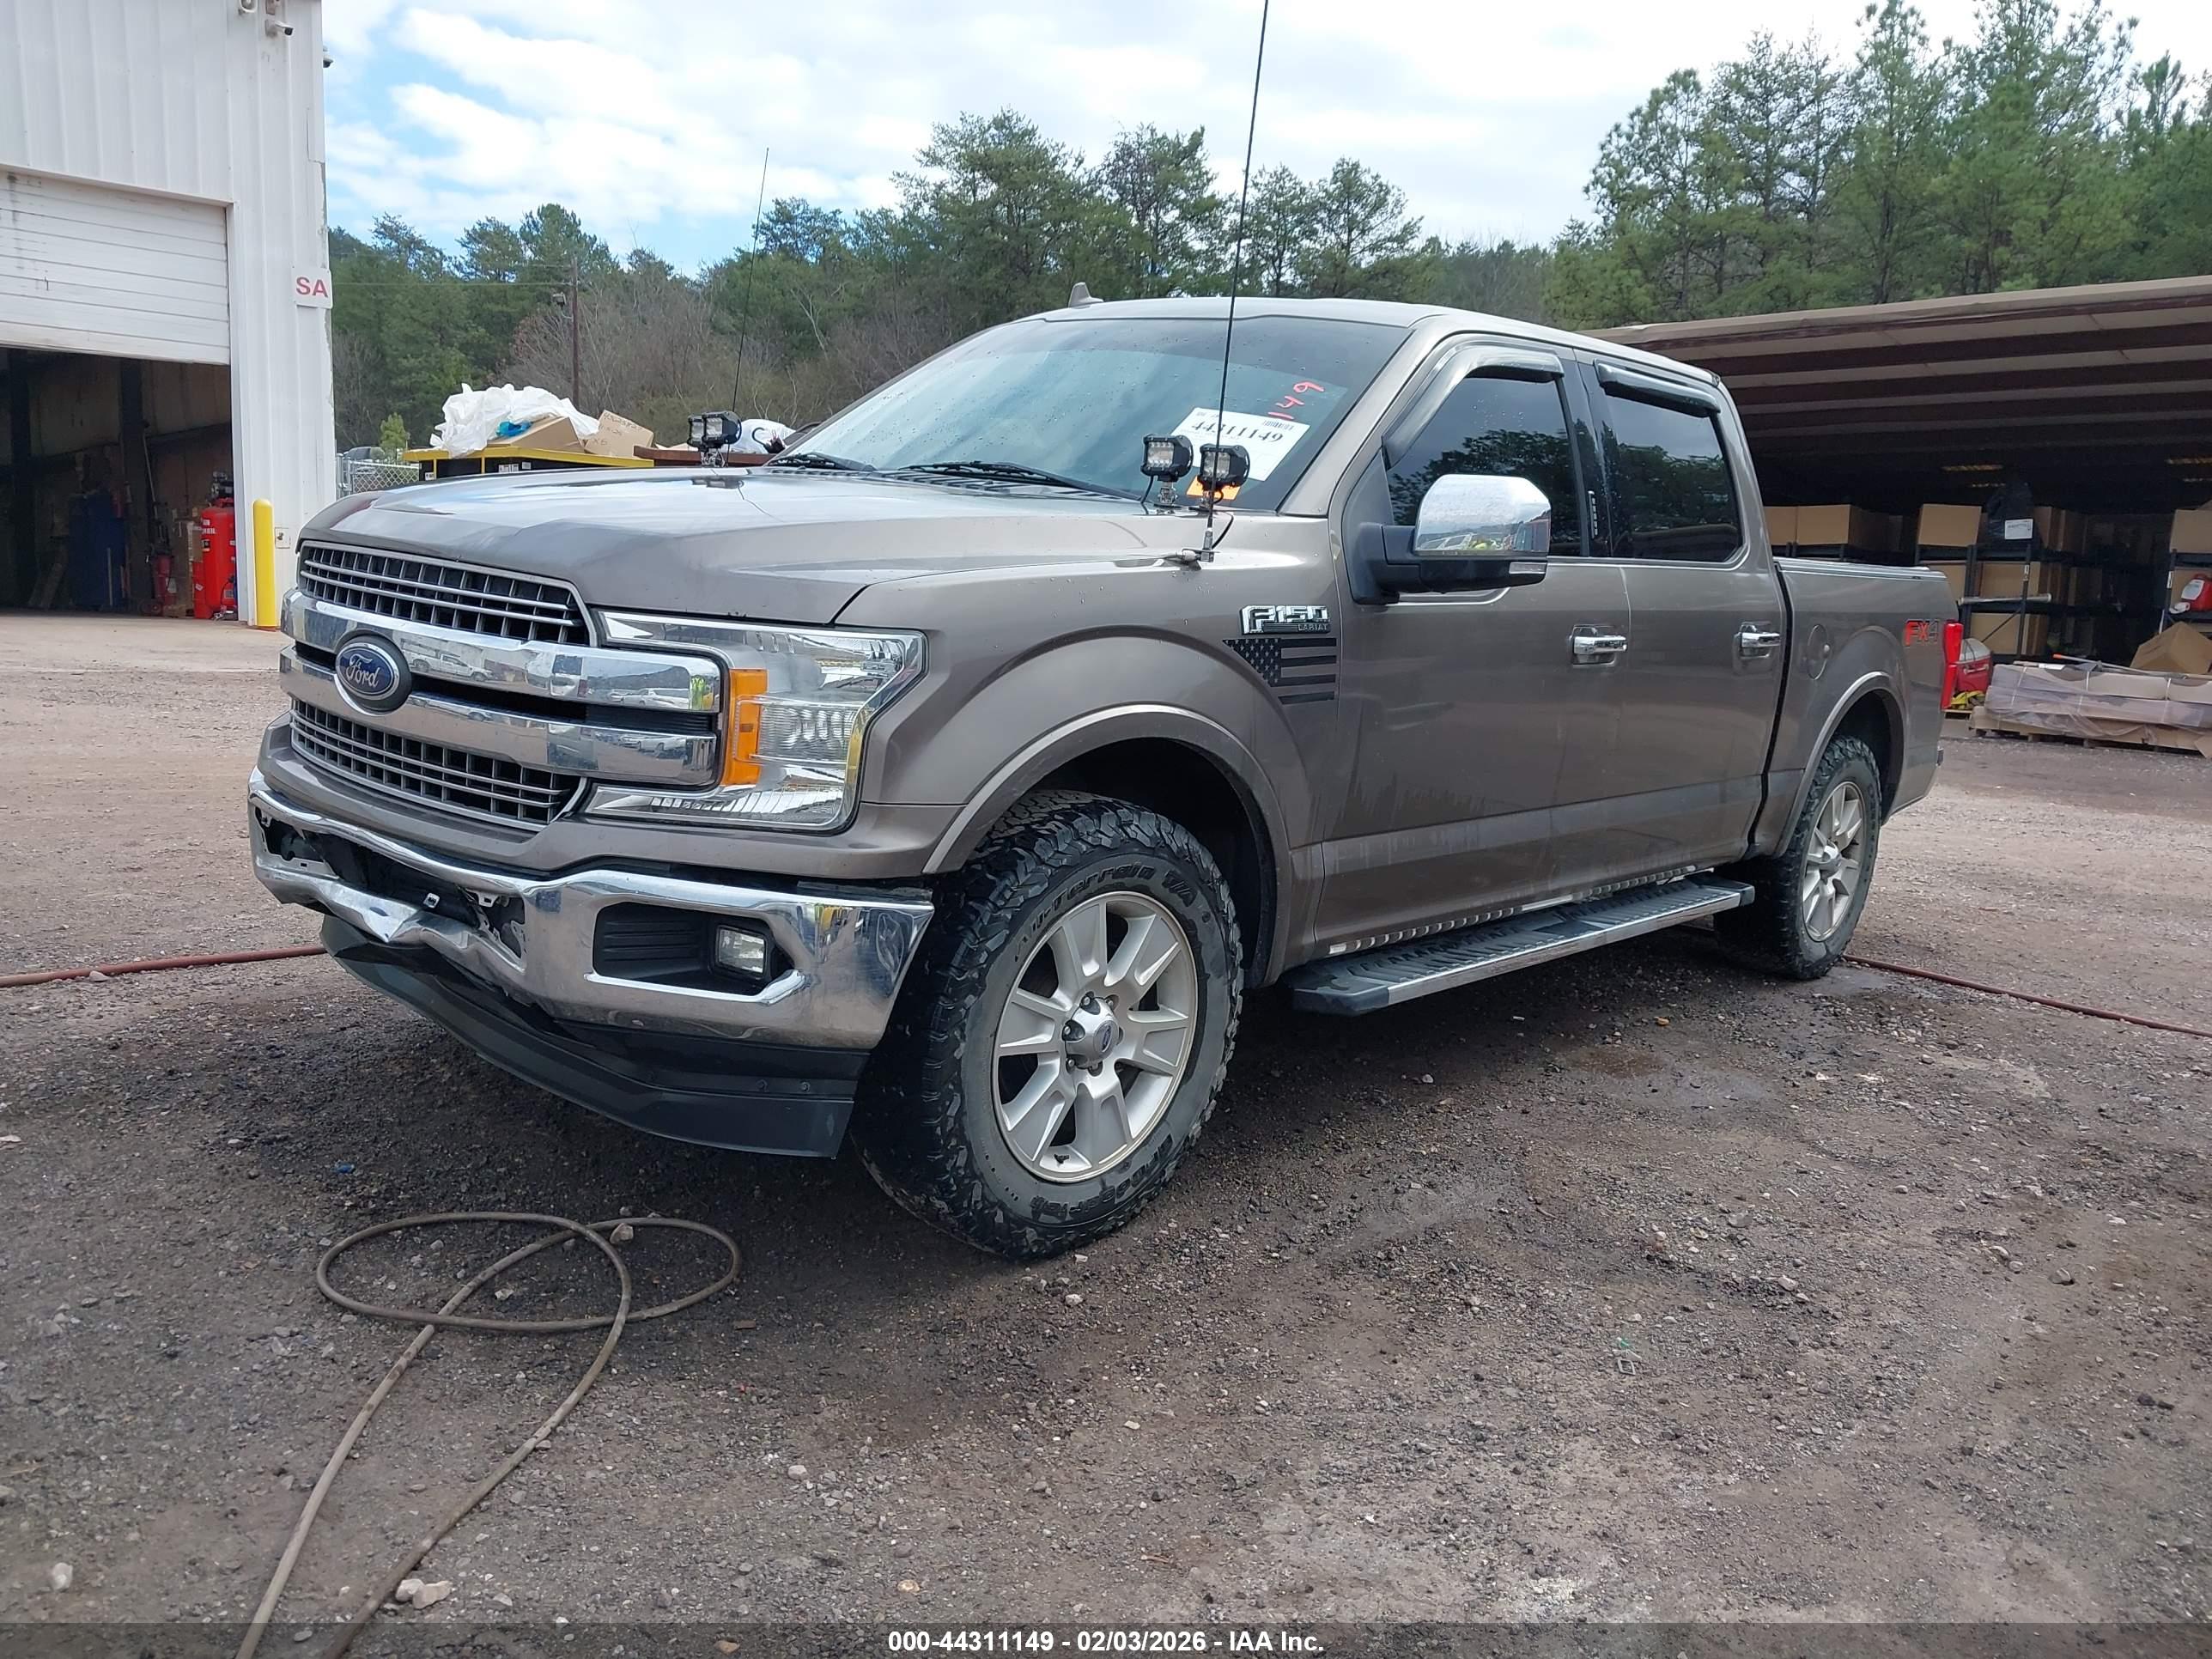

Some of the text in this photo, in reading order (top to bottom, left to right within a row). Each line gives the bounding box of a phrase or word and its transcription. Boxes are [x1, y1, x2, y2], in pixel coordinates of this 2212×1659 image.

[296, 276, 328, 298] SA
[1297, 623, 1328, 632] LARIAT
[1902, 618, 1938, 648] FX4
[345, 653, 380, 687] Ford
